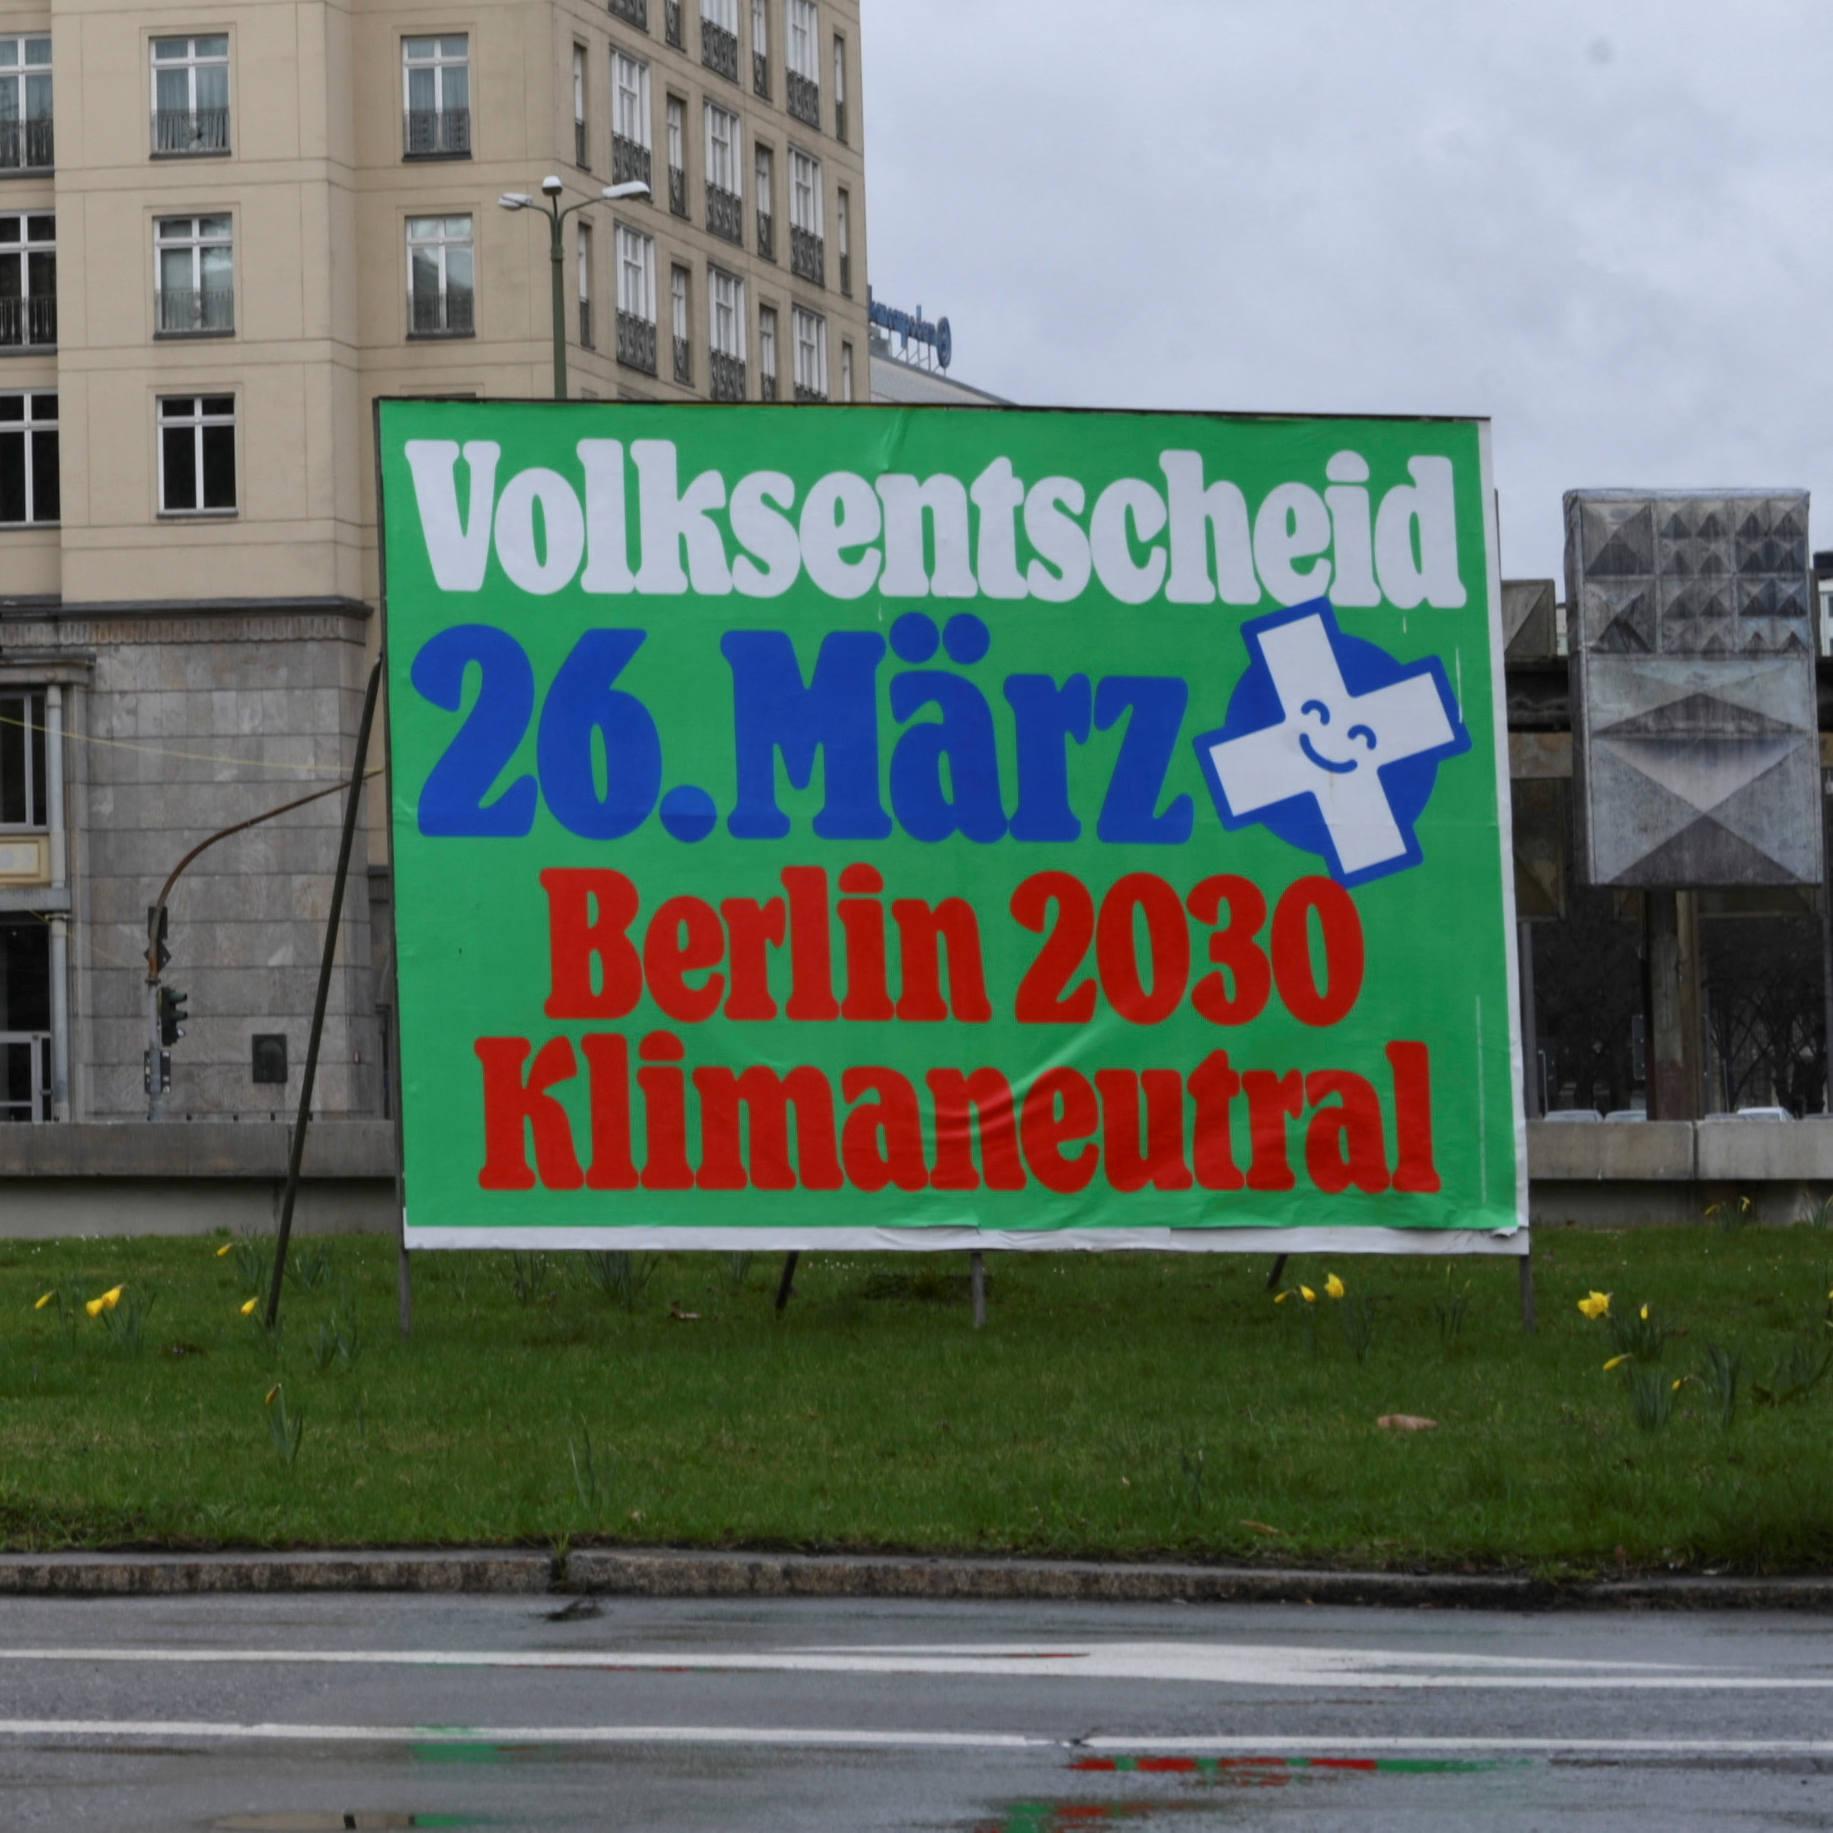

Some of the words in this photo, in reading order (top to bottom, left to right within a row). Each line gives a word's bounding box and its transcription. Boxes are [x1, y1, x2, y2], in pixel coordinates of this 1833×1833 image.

[405, 439, 1466, 608] Volksentscheid
[540, 863, 992, 1023] Berlin
[1010, 870, 1365, 1027] 2030
[475, 1030, 1442, 1194] Klimaneutral
